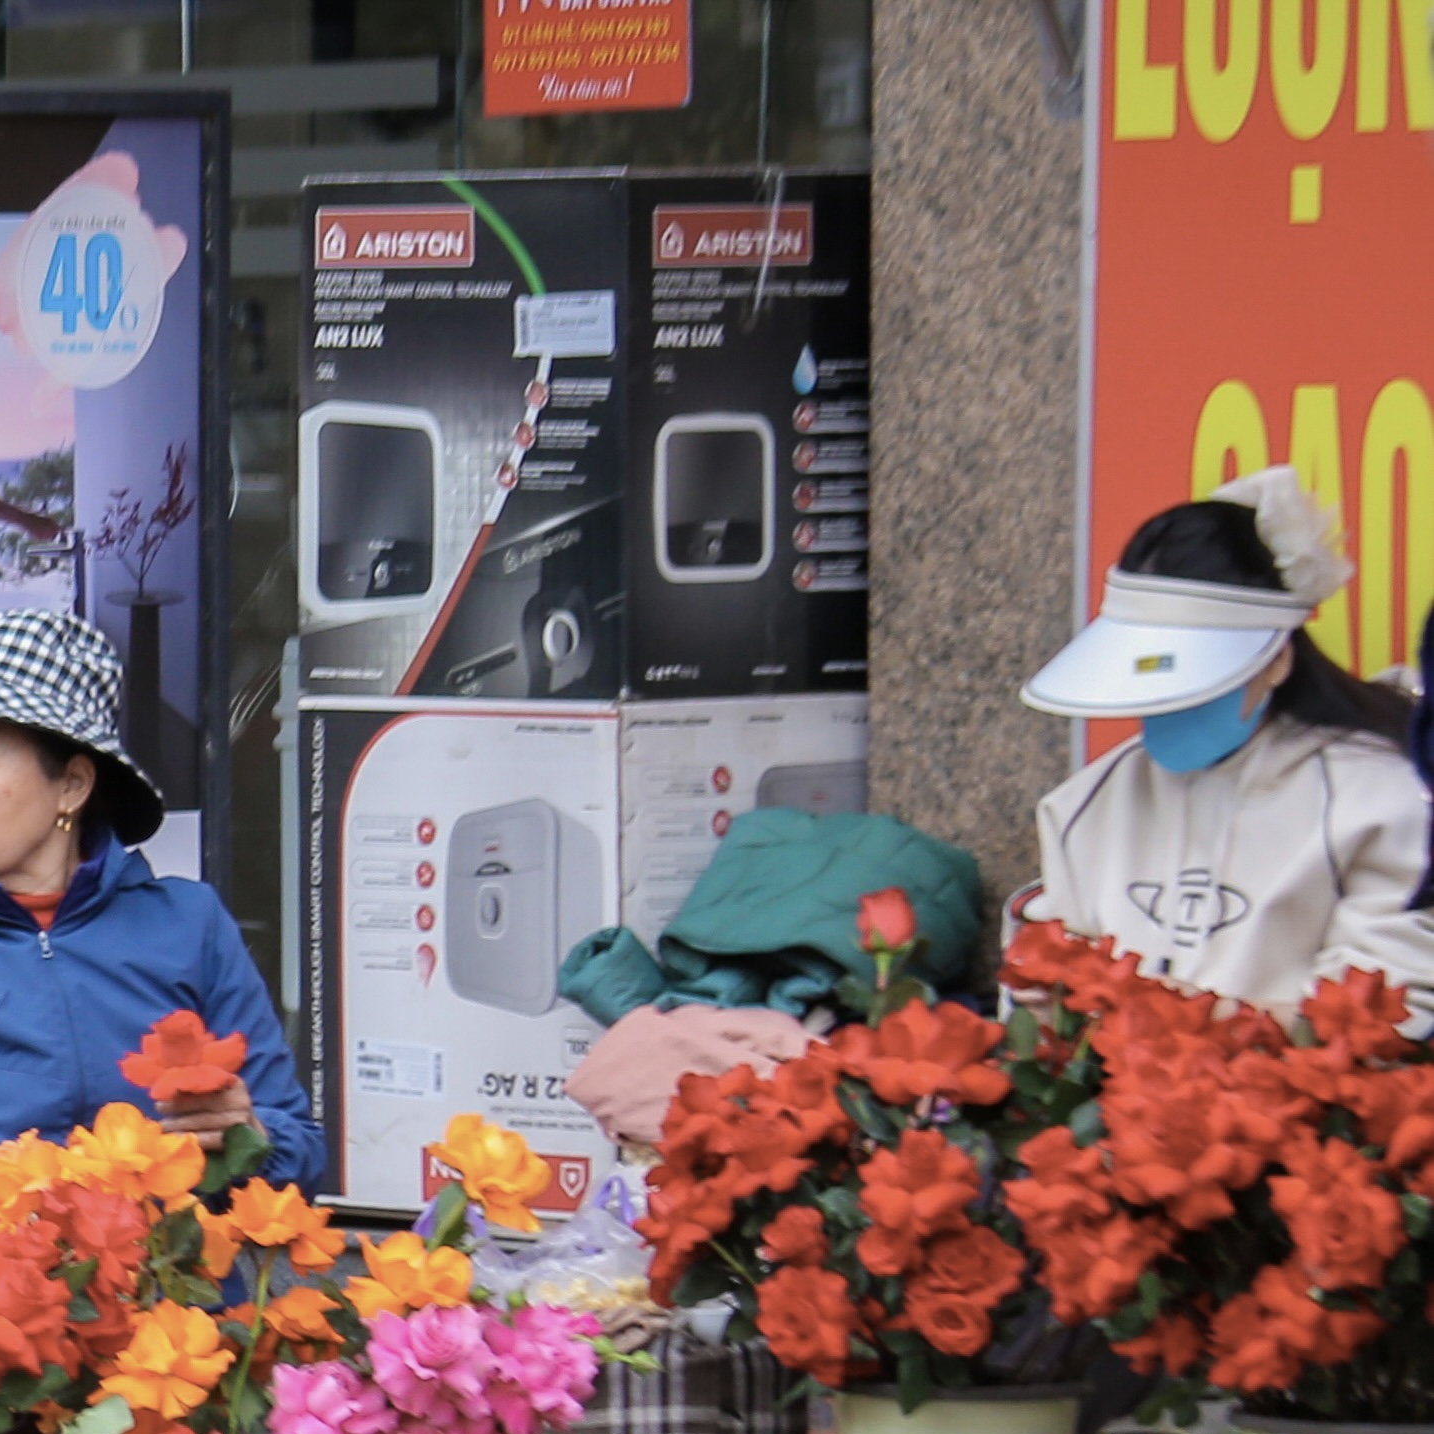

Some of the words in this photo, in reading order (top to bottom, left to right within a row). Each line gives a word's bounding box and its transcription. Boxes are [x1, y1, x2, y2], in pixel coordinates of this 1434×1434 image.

[355, 230, 464, 259] ARISTON
[693, 228, 803, 257] ARISTON
[351, 324, 385, 348] LUX
[690, 324, 725, 348] LUX
[311, 717, 325, 814] TECHNOLOGY
[310, 815, 324, 886] CONTROL
[310, 888, 323, 940] SMART
[522, 1074, 539, 1096] R
